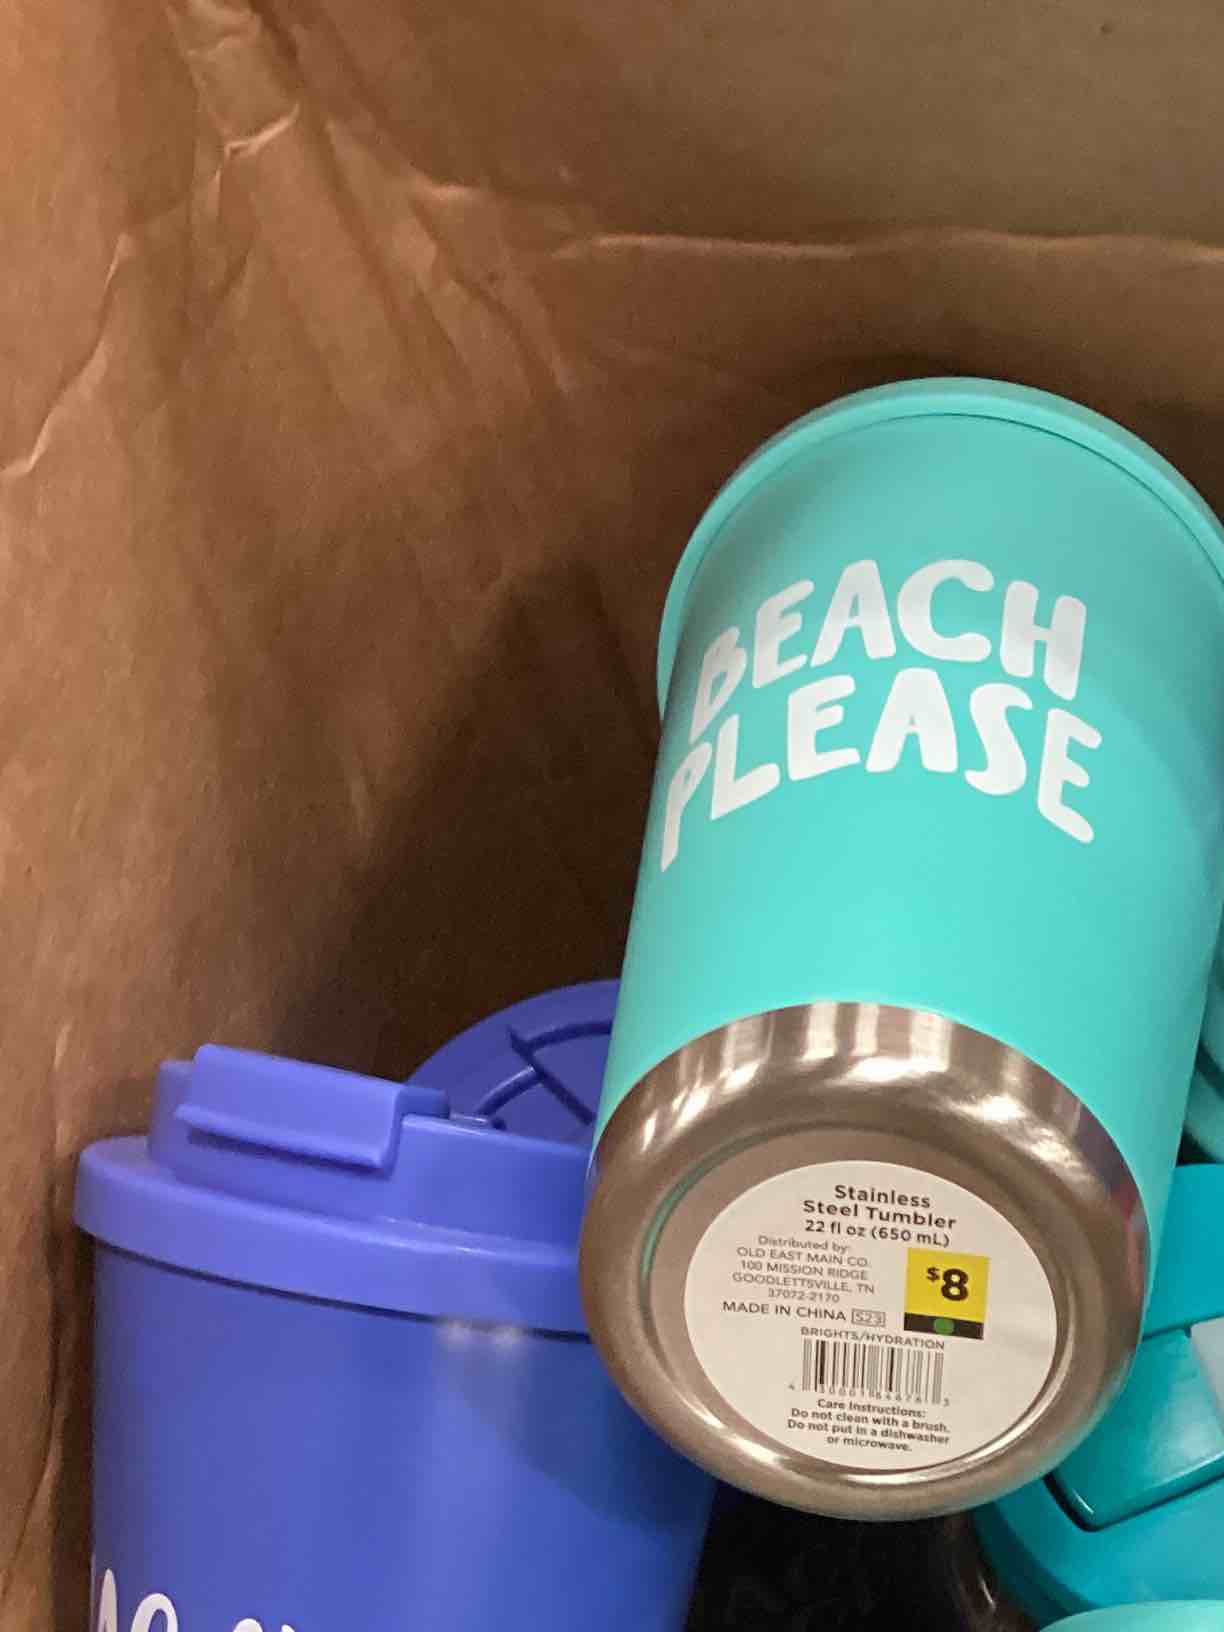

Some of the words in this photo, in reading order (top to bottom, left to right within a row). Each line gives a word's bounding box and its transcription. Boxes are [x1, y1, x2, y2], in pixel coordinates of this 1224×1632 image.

[688, 558, 1087, 745] BEACH
[660, 667, 1102, 873] PLEASE
[834, 1184, 931, 1208] Stainless
[803, 1199, 858, 1217] Steel
[865, 1205, 957, 1229] Tumbler
[758, 1235, 829, 1251] Distributed
[805, 1219, 825, 1233] 22
[830, 1221, 841, 1234] fl
[846, 1225, 867, 1238] oz
[871, 1226, 912, 1242] (650
[917, 1232, 951, 1249] mL)
[737, 1246, 766, 1258] OLD
[770, 1249, 802, 1261] EAST
[807, 1253, 843, 1266] MAIN
[767, 1262, 823, 1276] MISSION
[827, 1268, 868, 1280] RIDGE
[856, 1284, 875, 1294] TN
[926, 1266, 970, 1301] $8
[722, 1301, 770, 1314] MADE
[775, 1305, 791, 1316] IN
[796, 1307, 846, 1321] CHINA
[801, 1326, 945, 1349] BRIGHTS/HYDRATION
[791, 1408, 808, 1418] Do
[812, 1410, 832, 1420] not
[836, 1412, 869, 1424] clean
[872, 1415, 898, 1427] with
[902, 1420, 909, 1429] a
[817, 1399, 845, 1410] Care
[850, 1401, 927, 1418] Instructions:
[788, 1419, 805, 1429] Do
[808, 1421, 829, 1432] not
[832, 1423, 853, 1436] put
[856, 1424, 867, 1435] in
[870, 1428, 877, 1437] a
[880, 1427, 950, 1445] dishwasher
[827, 1436, 840, 1444] or
